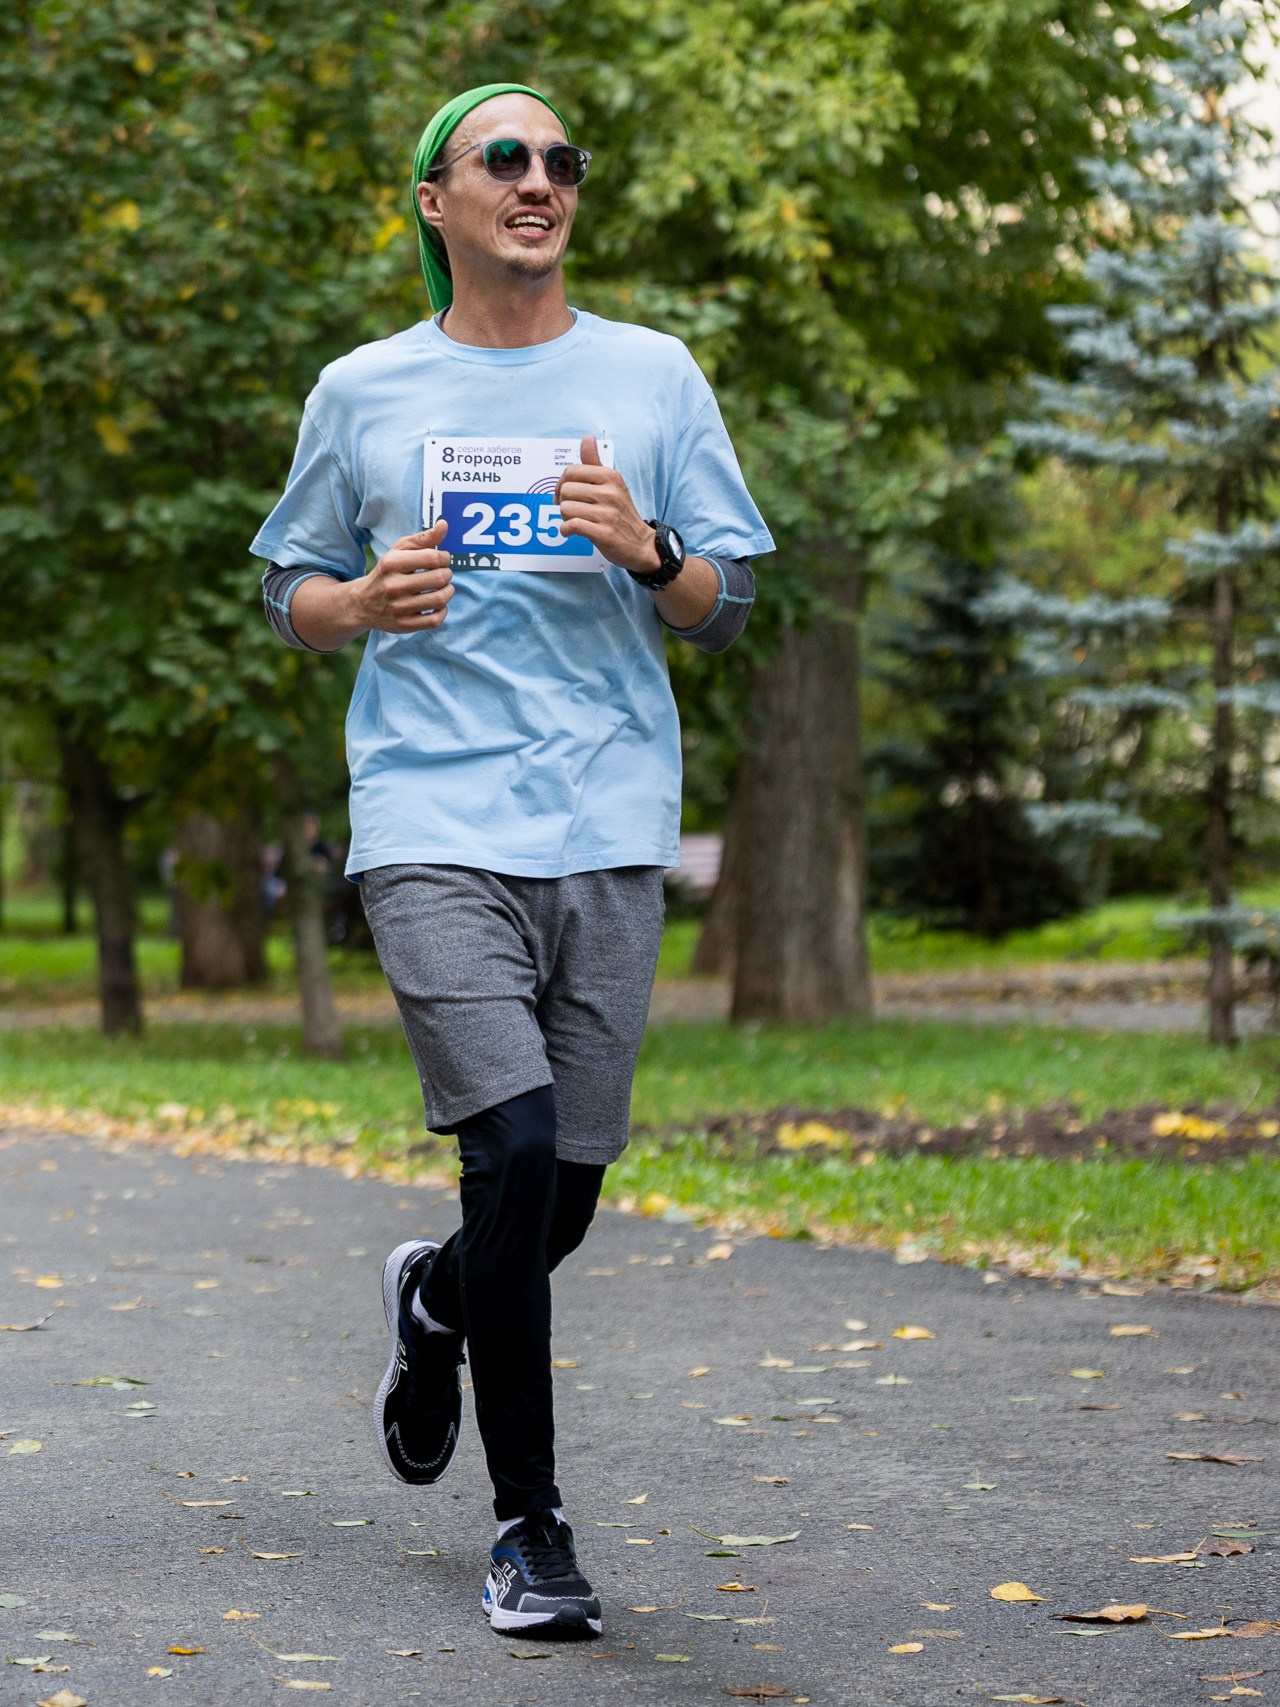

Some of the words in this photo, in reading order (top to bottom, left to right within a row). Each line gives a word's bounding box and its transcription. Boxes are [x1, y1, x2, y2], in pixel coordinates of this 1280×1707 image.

[442, 447, 455, 464] 8
[457, 454, 521, 467] городов
[457, 446, 484, 455] серия
[487, 446, 522, 454] забегов
[441, 471, 501, 483] КАЗАНЬ
[462, 502, 569, 547] 235
